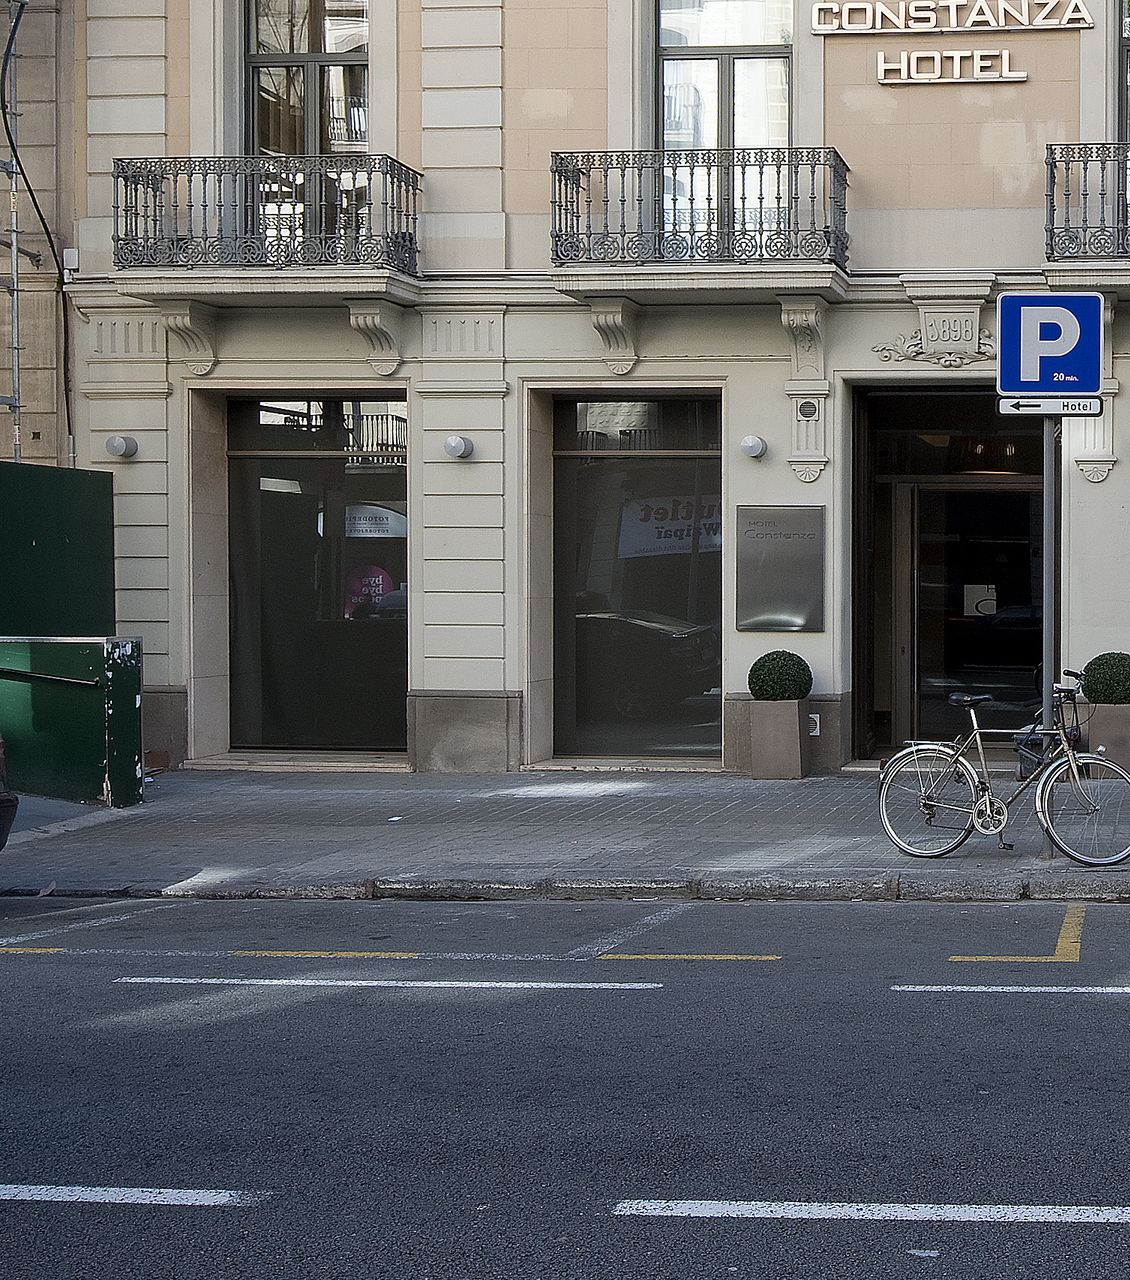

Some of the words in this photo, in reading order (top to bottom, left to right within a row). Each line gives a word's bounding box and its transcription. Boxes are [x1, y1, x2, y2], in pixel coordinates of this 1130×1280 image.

[877, 49, 1028, 80] HOTEL
[928, 318, 974, 342] 1898
[1020, 306, 1081, 382] P
[1053, 373, 1064, 381] 20
[1062, 401, 1092, 412] Hotel
[744, 529, 816, 540] Constanza
